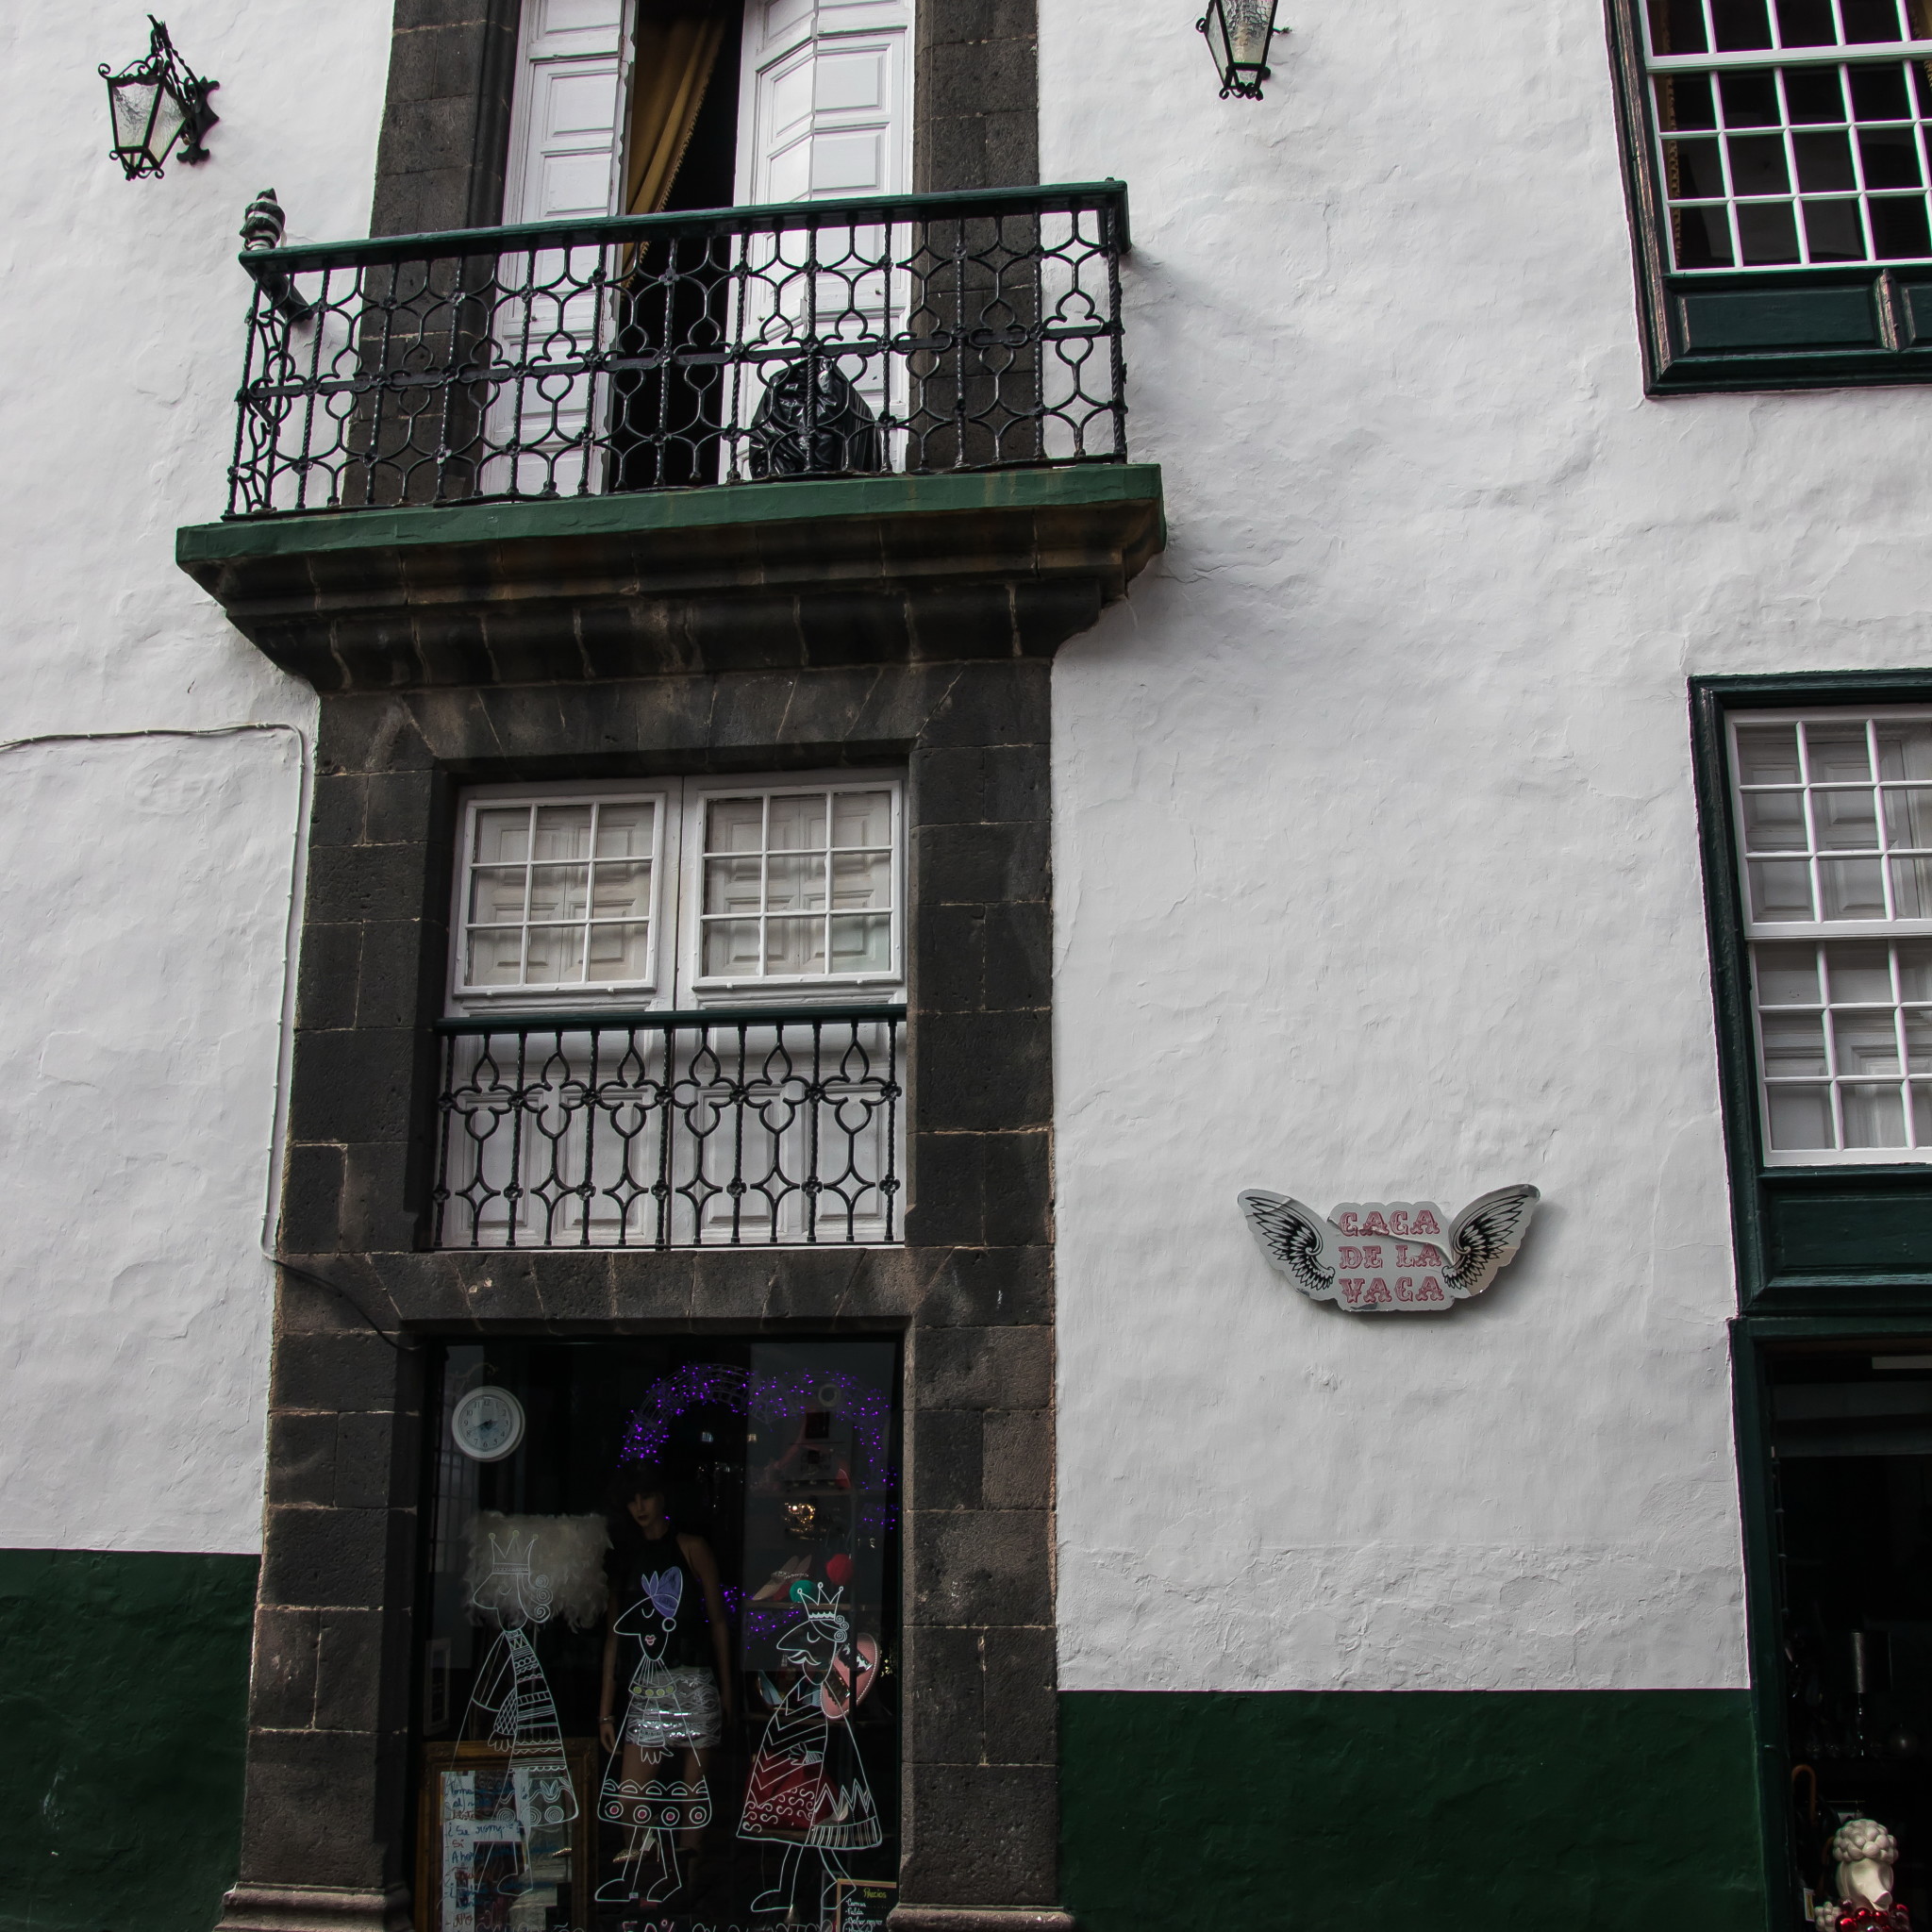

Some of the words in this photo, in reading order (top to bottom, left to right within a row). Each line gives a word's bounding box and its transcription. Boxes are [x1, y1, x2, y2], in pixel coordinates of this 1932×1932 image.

[1339, 1209, 1441, 1237] CACA
[1339, 1245, 1383, 1269] DE
[1395, 1243, 1441, 1268] LA
[1339, 1276, 1444, 1303] VACA
